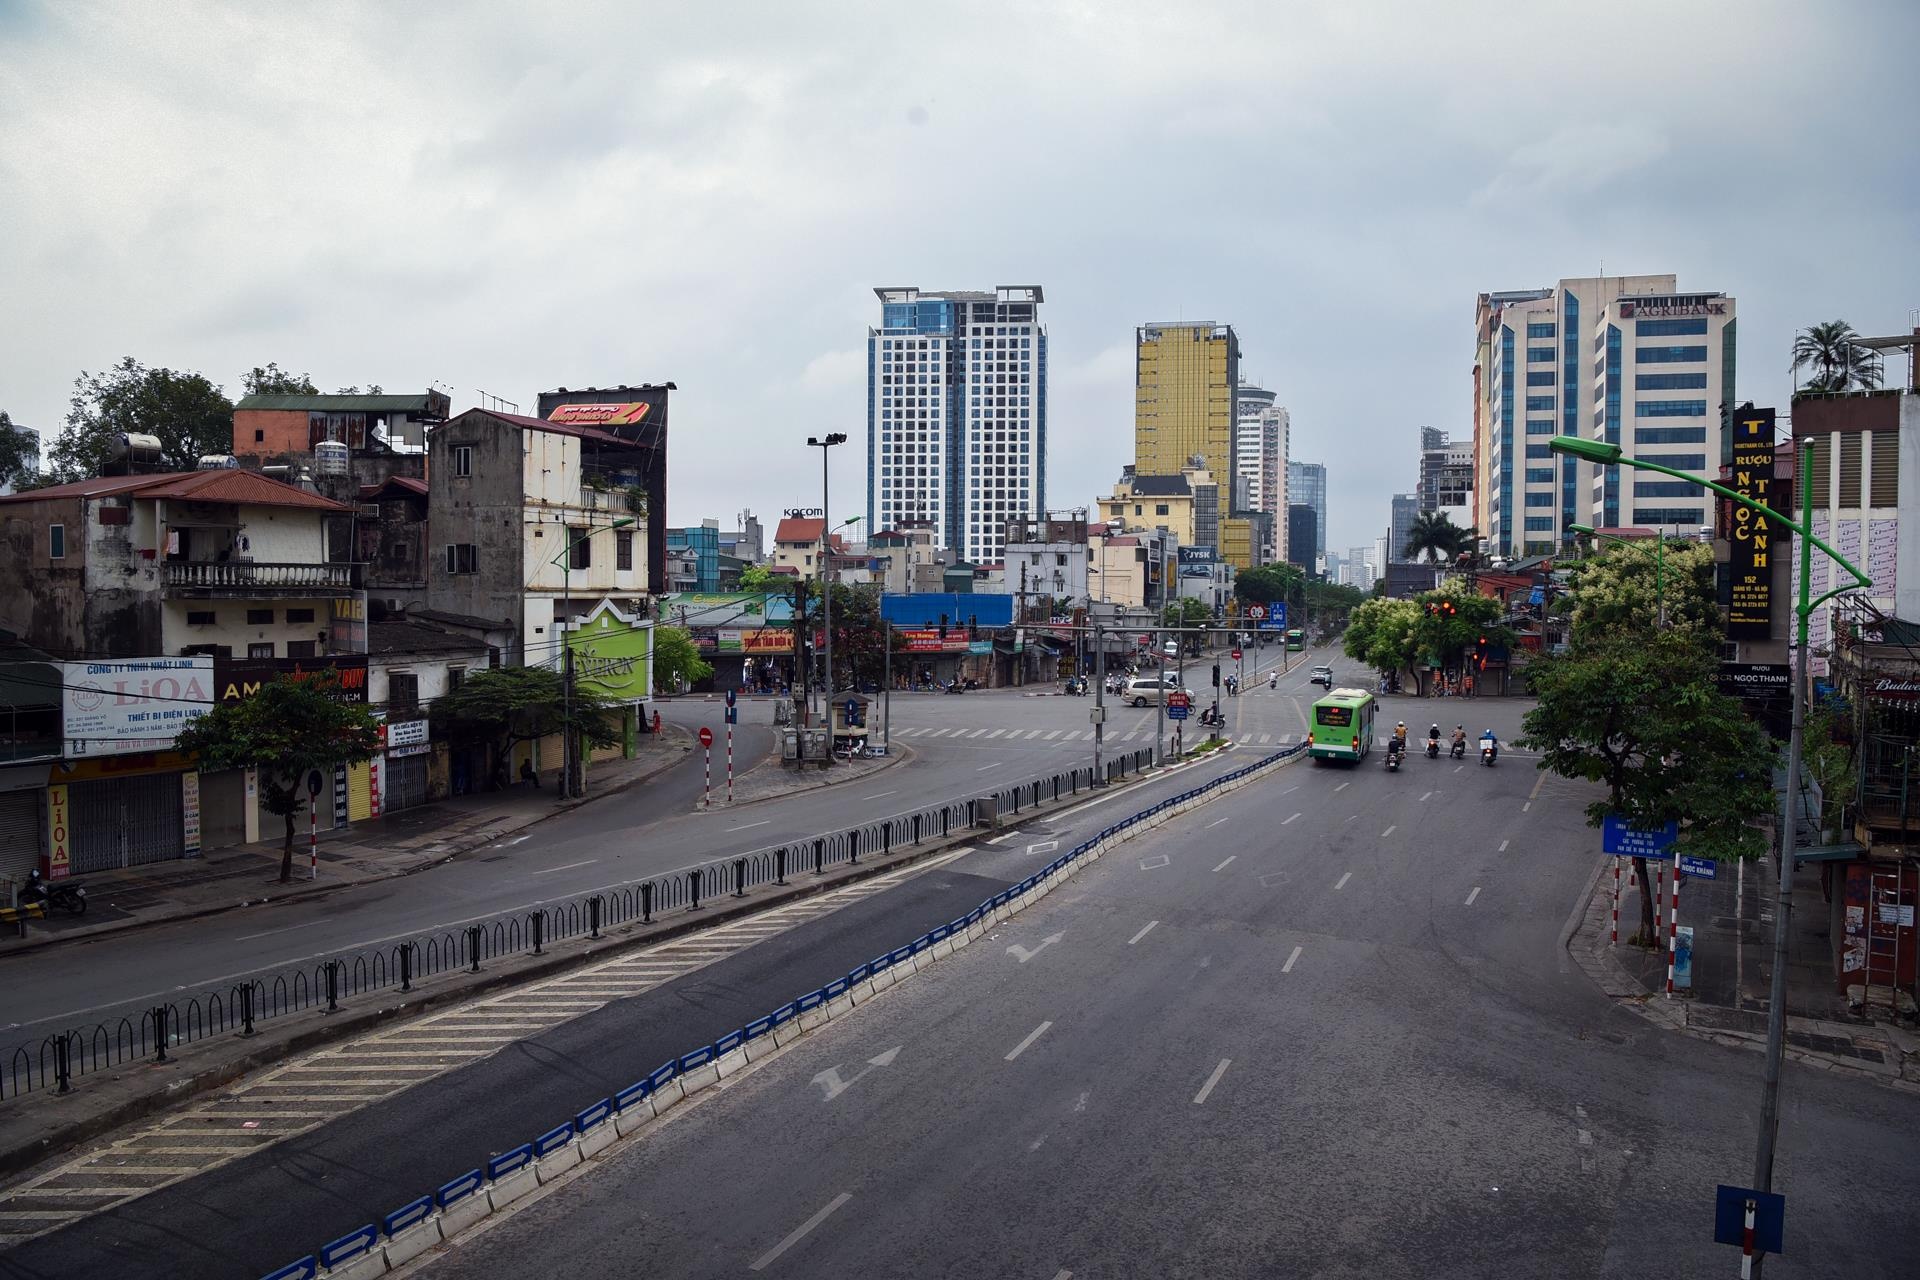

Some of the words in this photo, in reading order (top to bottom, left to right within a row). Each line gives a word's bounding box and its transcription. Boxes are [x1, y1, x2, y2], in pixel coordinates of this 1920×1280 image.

[1637, 303, 1726, 317] AGRIBANK
[1743, 419, 1765, 434] T
[1735, 454, 1772, 468] RƯỢU
[1189, 551, 1210, 559] JYSK
[1744, 575, 1757, 584] 152
[87, 662, 112, 675] CÔNG
[114, 664, 124, 673] TY
[127, 663, 149, 673] TNHH
[174, 660, 193, 670] LINH
[1751, 665, 1771, 673] RƯỢU
[341, 667, 366, 689] DUY
[1733, 674, 1759, 685] NGỌC
[1759, 674, 1788, 684] THANH
[113, 677, 209, 707] LiOA
[128, 711, 151, 723] THIẾT
[152, 712, 161, 722] BỊ
[163, 710, 183, 721] ĐIỆN
[52, 791, 67, 861] LiOA
[1681, 864, 1696, 874] NGỌC
[1696, 865, 1714, 876] KHÁNH
